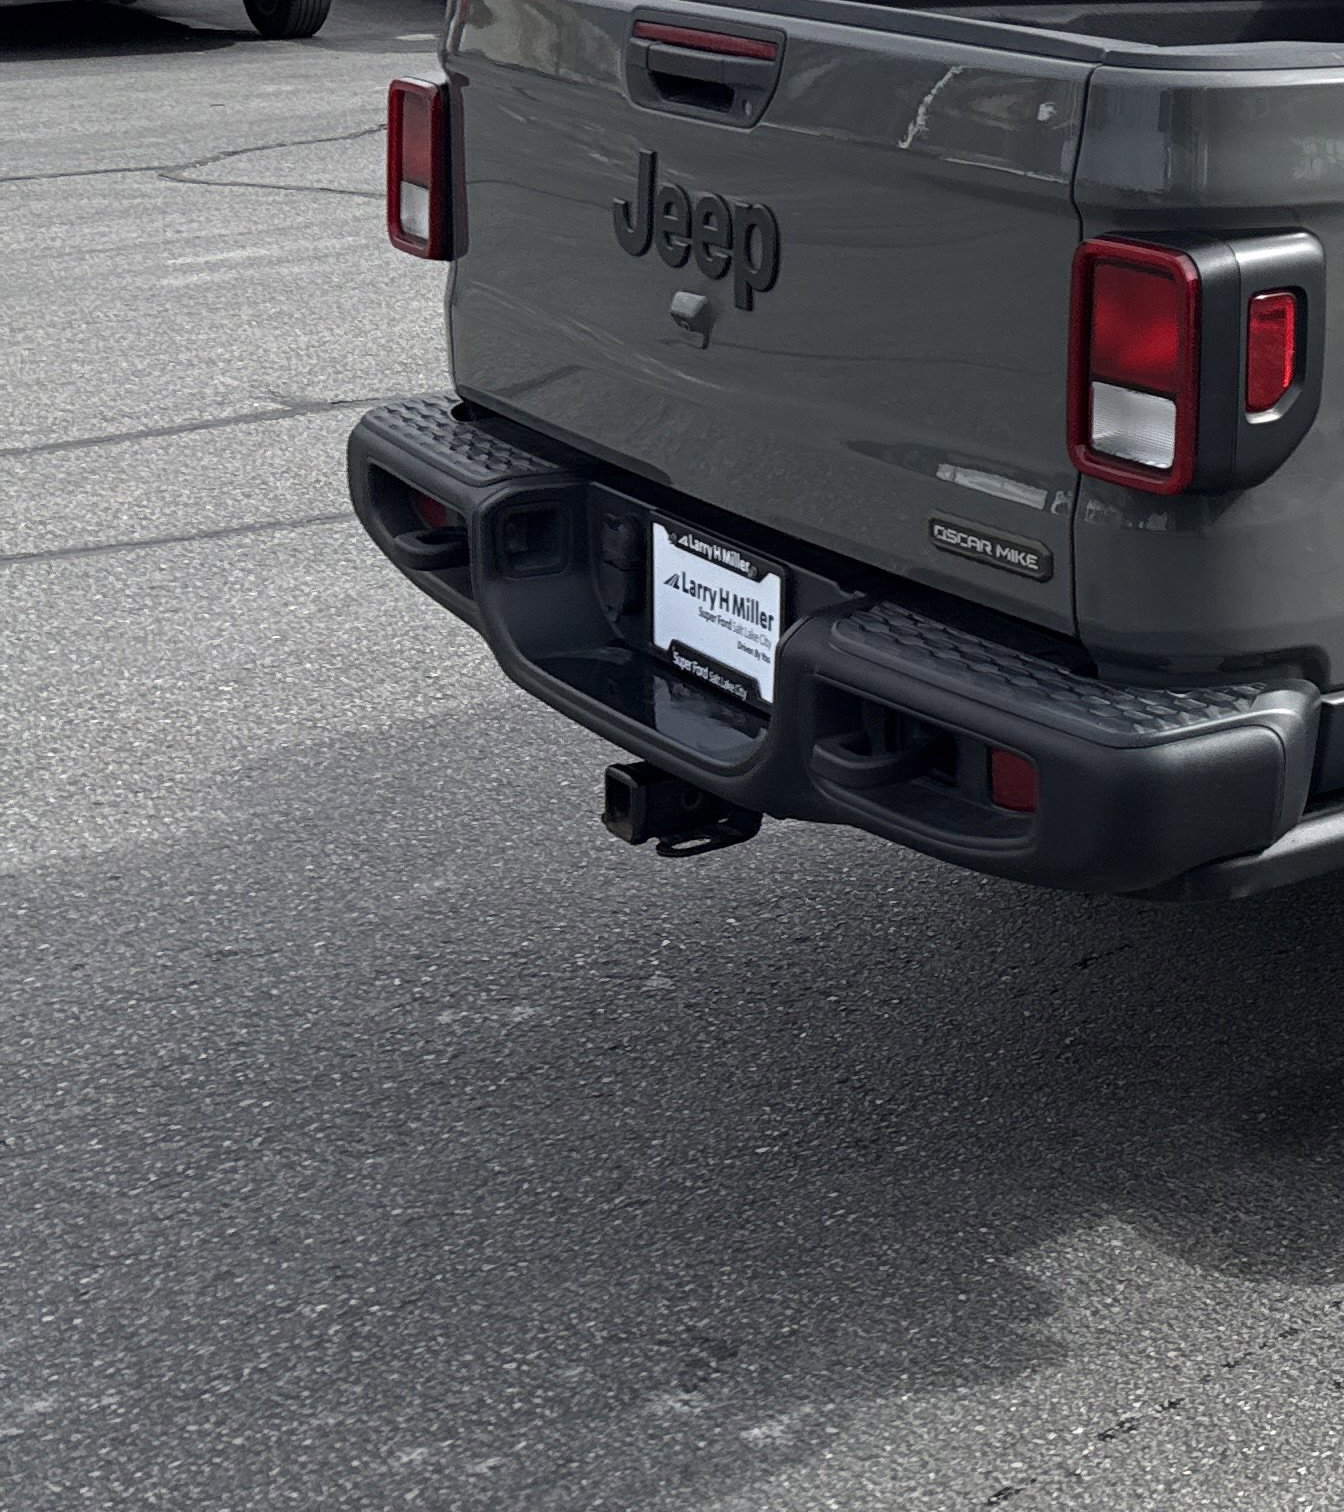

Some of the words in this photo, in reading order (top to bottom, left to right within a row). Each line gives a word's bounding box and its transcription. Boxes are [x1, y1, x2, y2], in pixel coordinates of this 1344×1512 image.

[612, 148, 781, 311] Jeep
[688, 534, 713, 560] Larry
[722, 549, 750, 572] Miller
[933, 525, 992, 555] OSCAR
[995, 544, 1039, 570] MIKE
[682, 571, 717, 610] Larry
[719, 588, 730, 612] H
[732, 594, 774, 631] Miller
